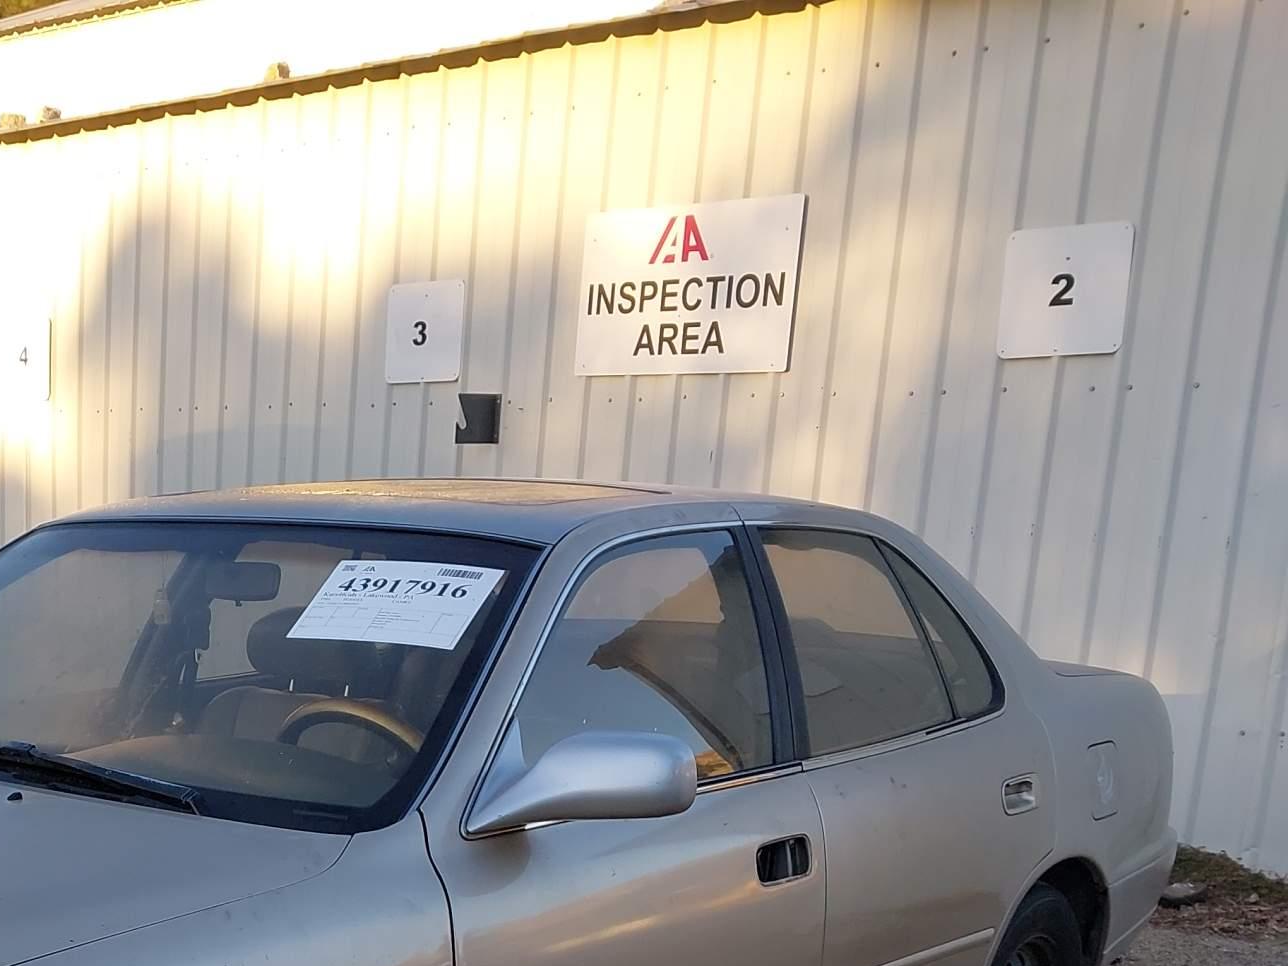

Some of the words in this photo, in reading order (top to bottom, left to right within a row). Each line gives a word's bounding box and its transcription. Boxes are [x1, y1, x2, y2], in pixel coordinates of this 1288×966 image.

[586, 271, 787, 316] INSPECTION
[1048, 272, 1076, 308] 2
[411, 320, 428, 347] 3
[632, 320, 725, 357] AREA
[19, 345, 29, 367] 4
[337, 577, 473, 599] 43917916
